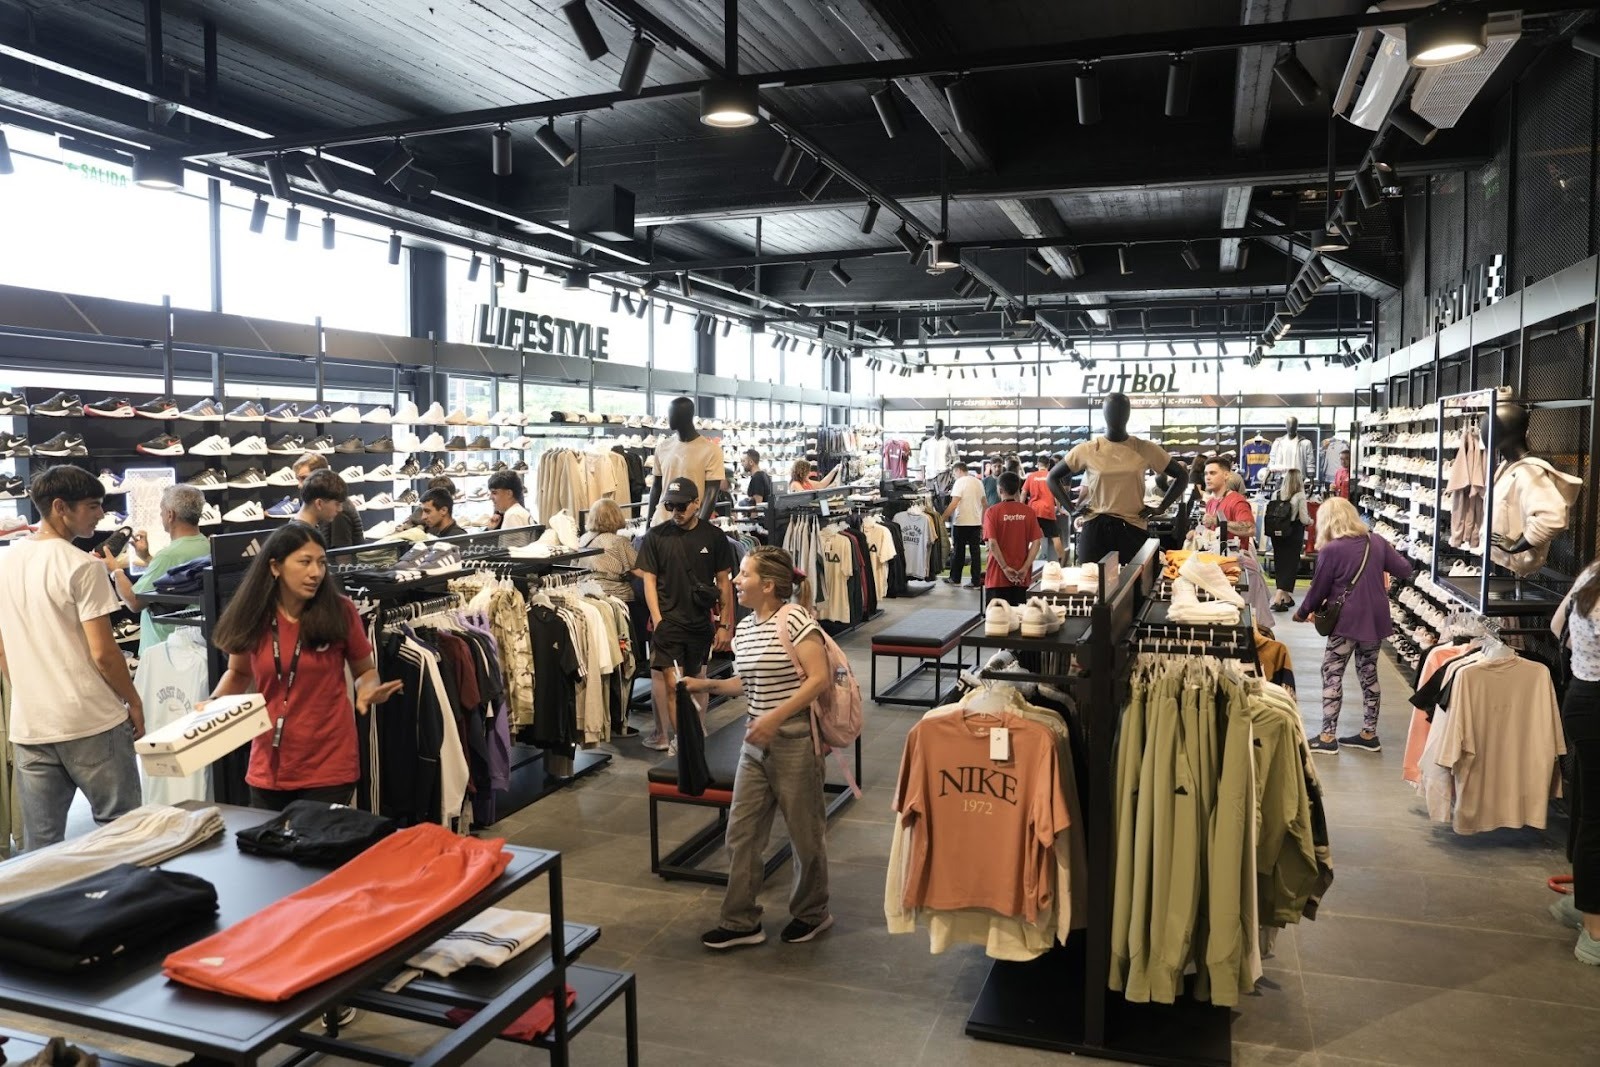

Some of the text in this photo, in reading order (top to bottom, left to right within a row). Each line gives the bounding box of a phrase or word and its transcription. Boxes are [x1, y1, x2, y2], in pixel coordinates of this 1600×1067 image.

[81, 163, 127, 185] SALIDA
[478, 303, 609, 360] LIFESTYLE
[1082, 373, 1180, 394] FUTBOL
[1003, 514, 1026, 522] Dexter
[938, 766, 1018, 806] NIKE
[962, 799, 993, 815] 1972
